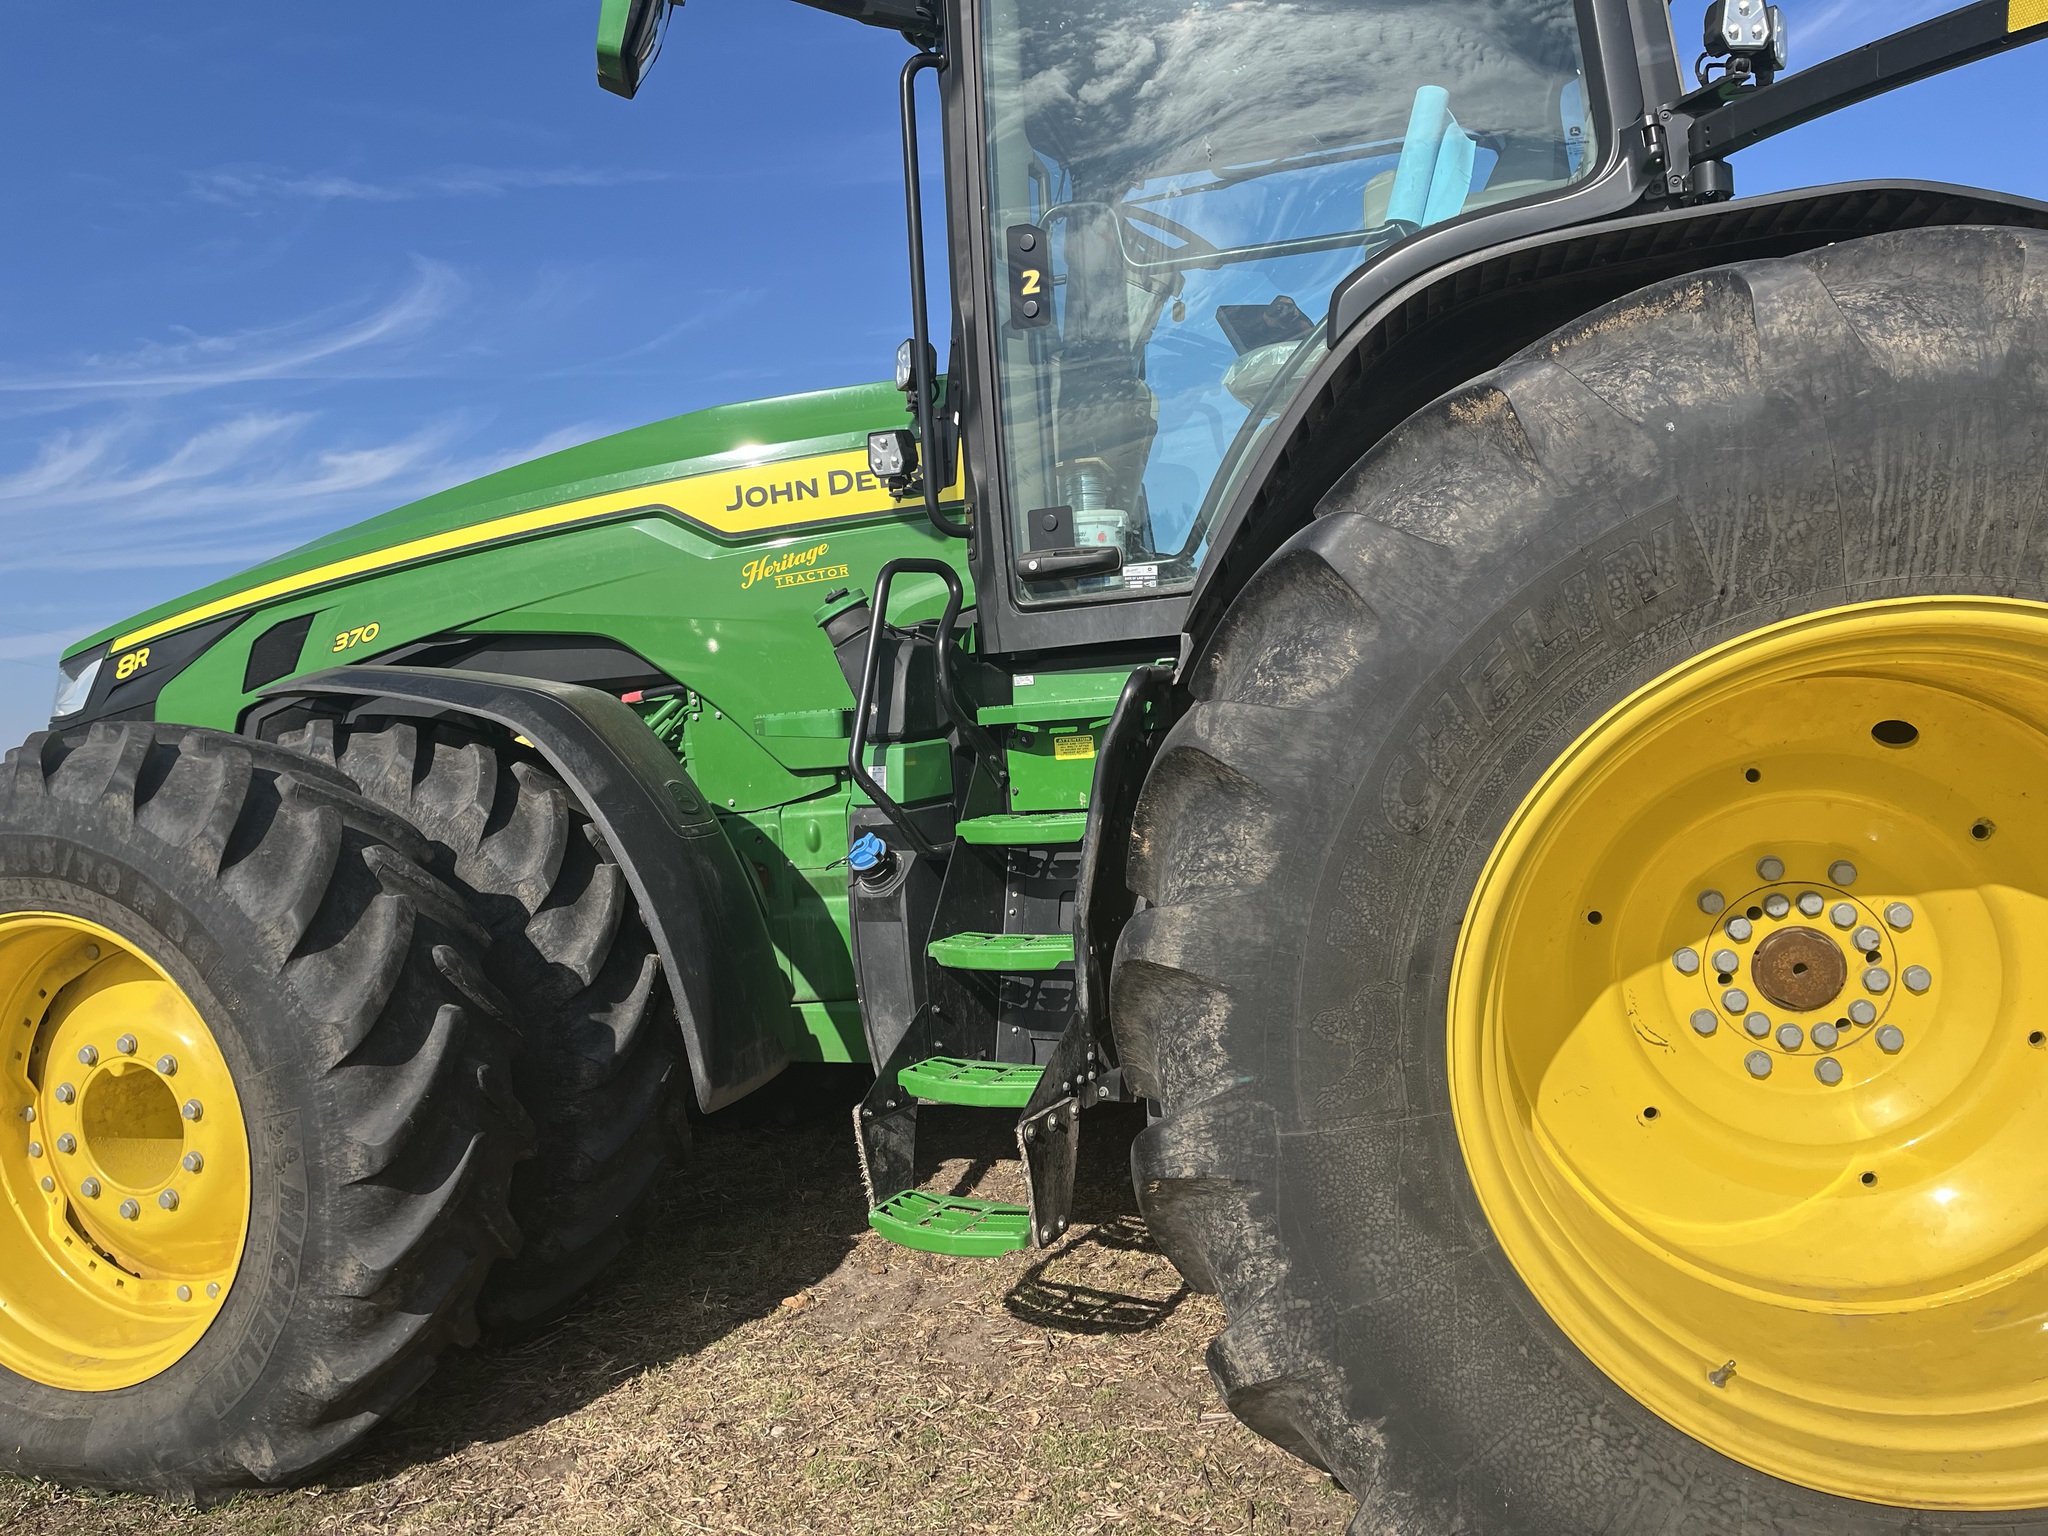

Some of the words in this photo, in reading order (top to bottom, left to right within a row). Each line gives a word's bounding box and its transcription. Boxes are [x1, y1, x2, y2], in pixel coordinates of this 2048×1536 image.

[1021, 269, 1041, 295] 2
[726, 477, 819, 511] JOHN
[741, 543, 829, 589] Heritage
[775, 565, 848, 586] TRACTOR
[332, 622, 380, 653] 370
[115, 647, 151, 680] 8R
